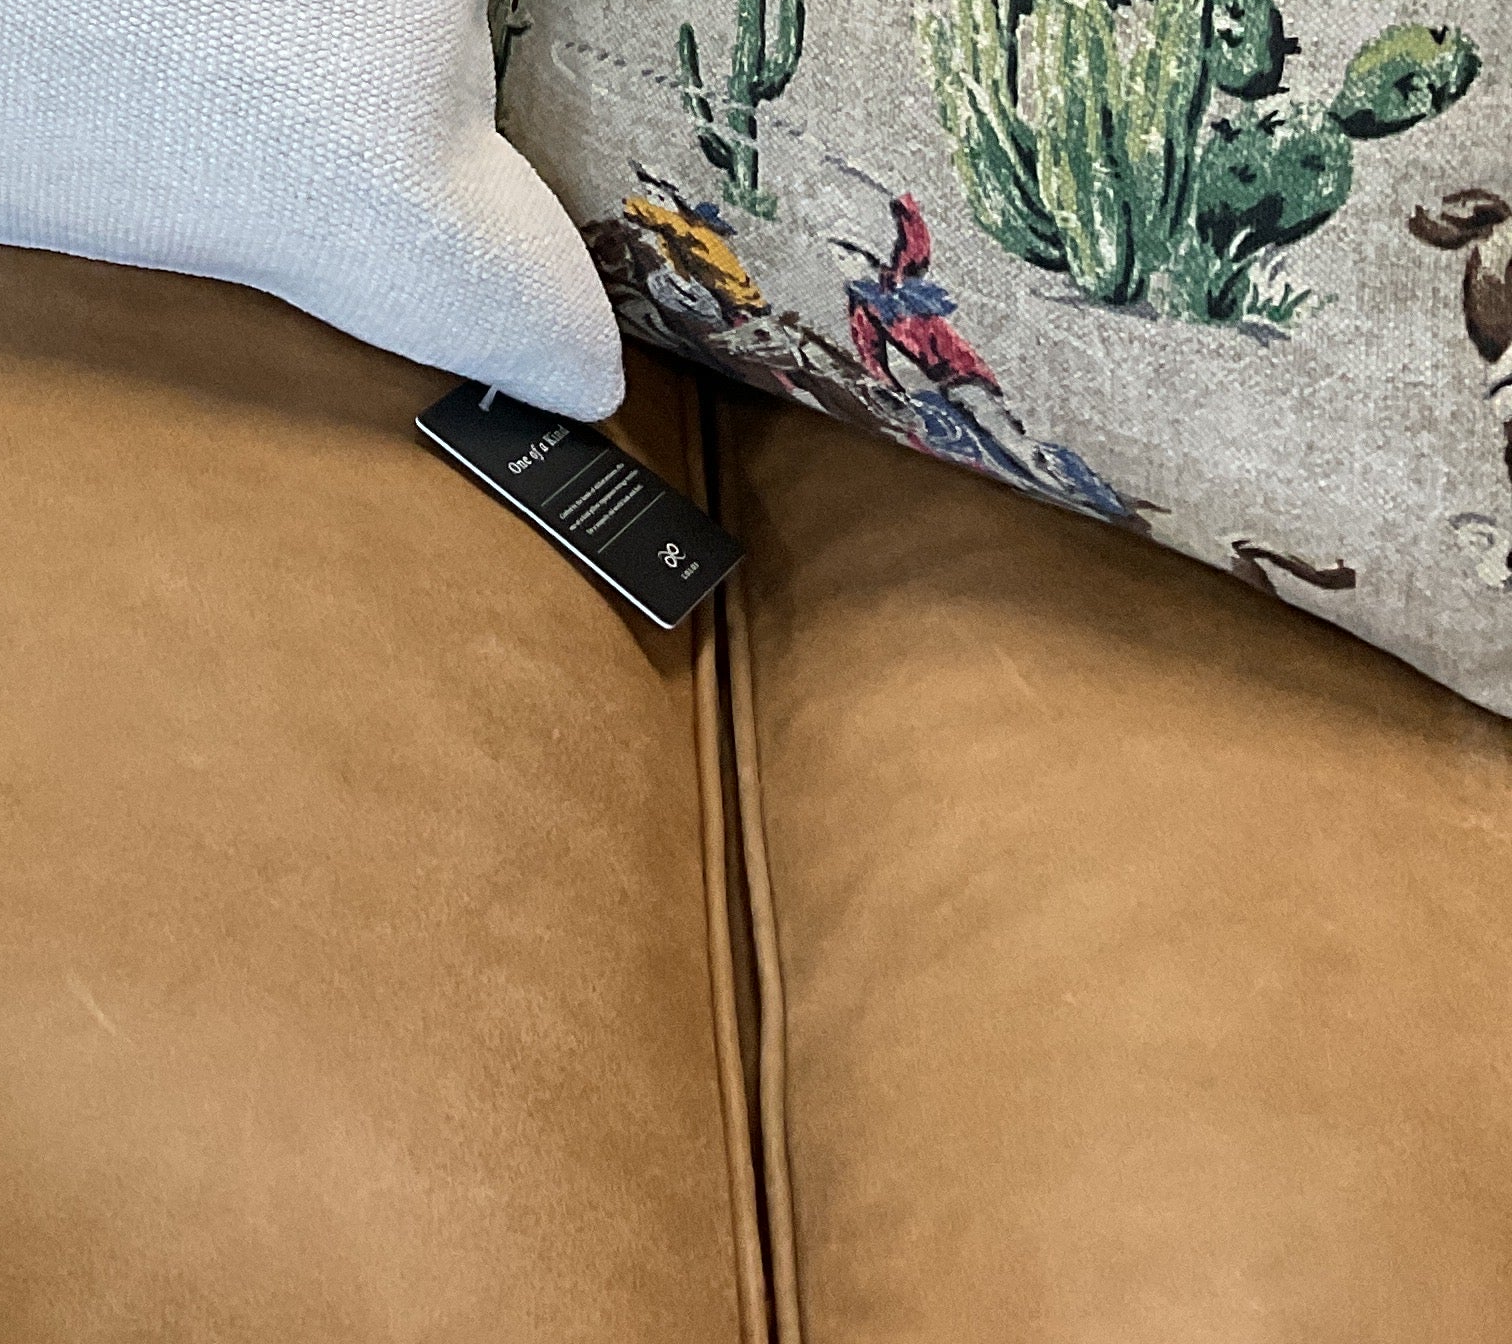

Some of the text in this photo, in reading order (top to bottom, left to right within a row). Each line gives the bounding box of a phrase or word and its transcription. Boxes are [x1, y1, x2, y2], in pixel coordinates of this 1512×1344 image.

[508, 424, 570, 474] One of a Kind
